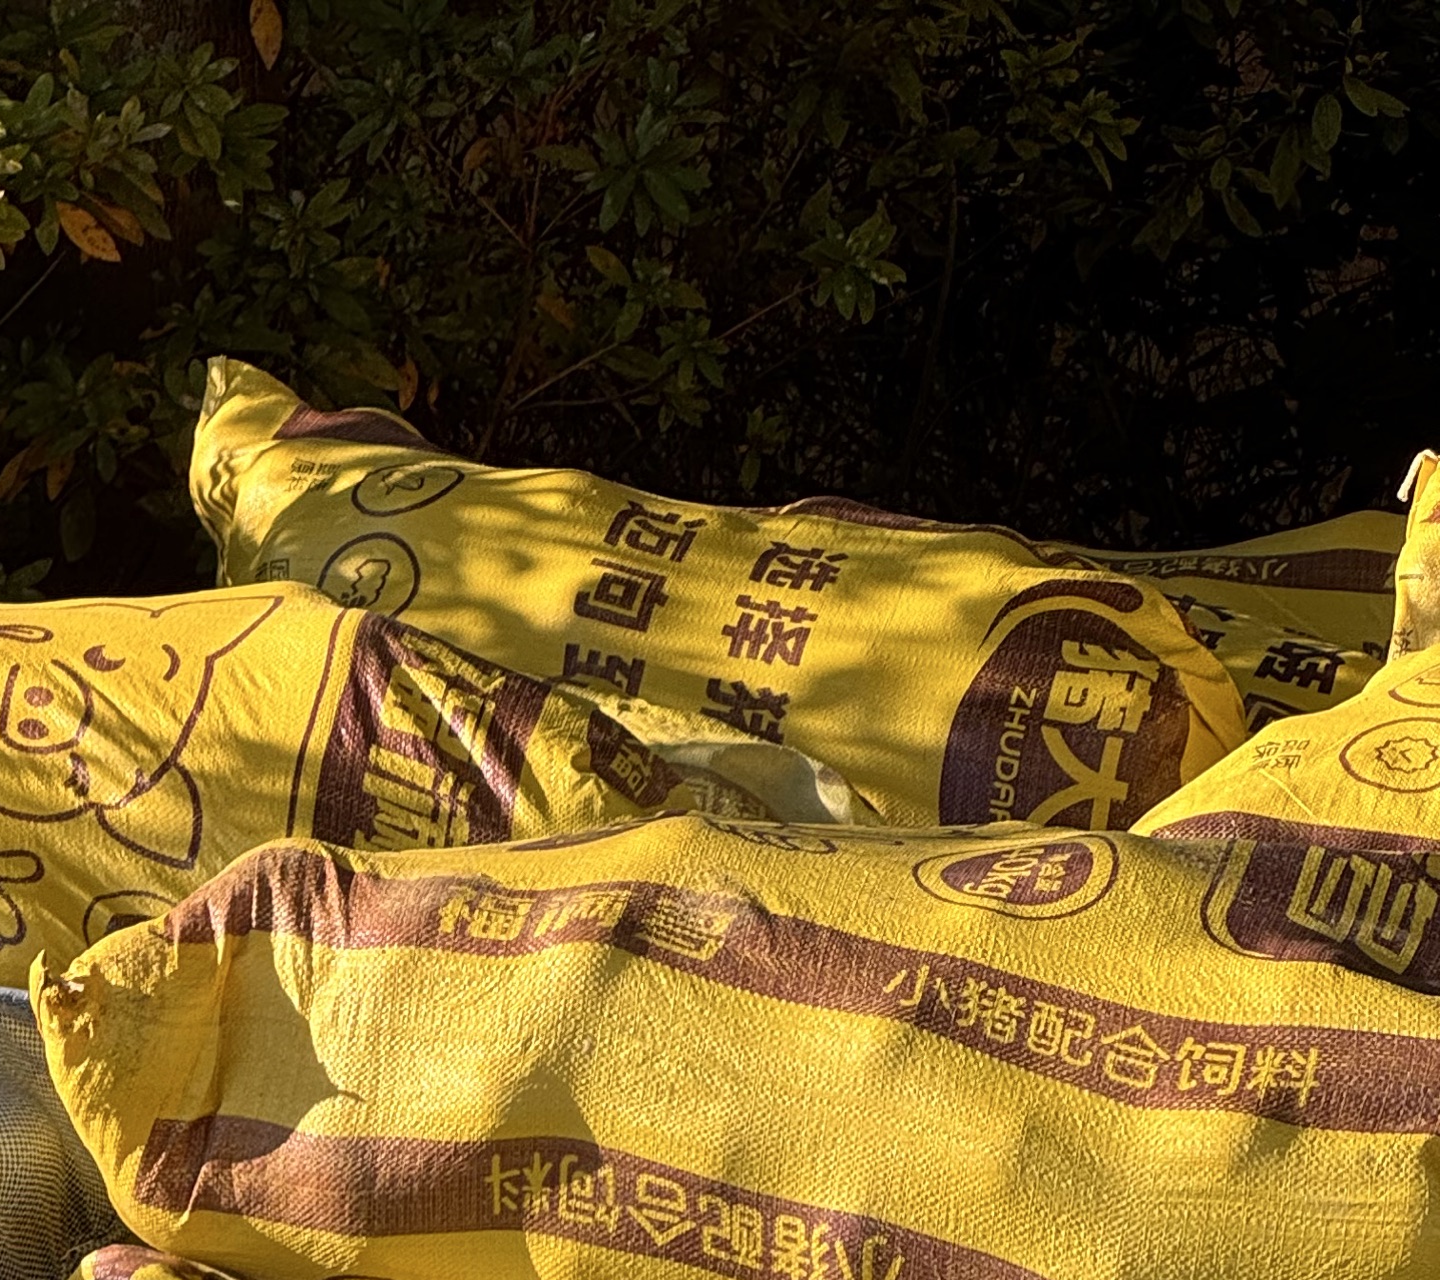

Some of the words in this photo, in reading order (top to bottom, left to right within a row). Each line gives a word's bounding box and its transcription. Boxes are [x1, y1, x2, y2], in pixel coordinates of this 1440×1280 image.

[882, 961, 1319, 1108] 小猪配合饲料
